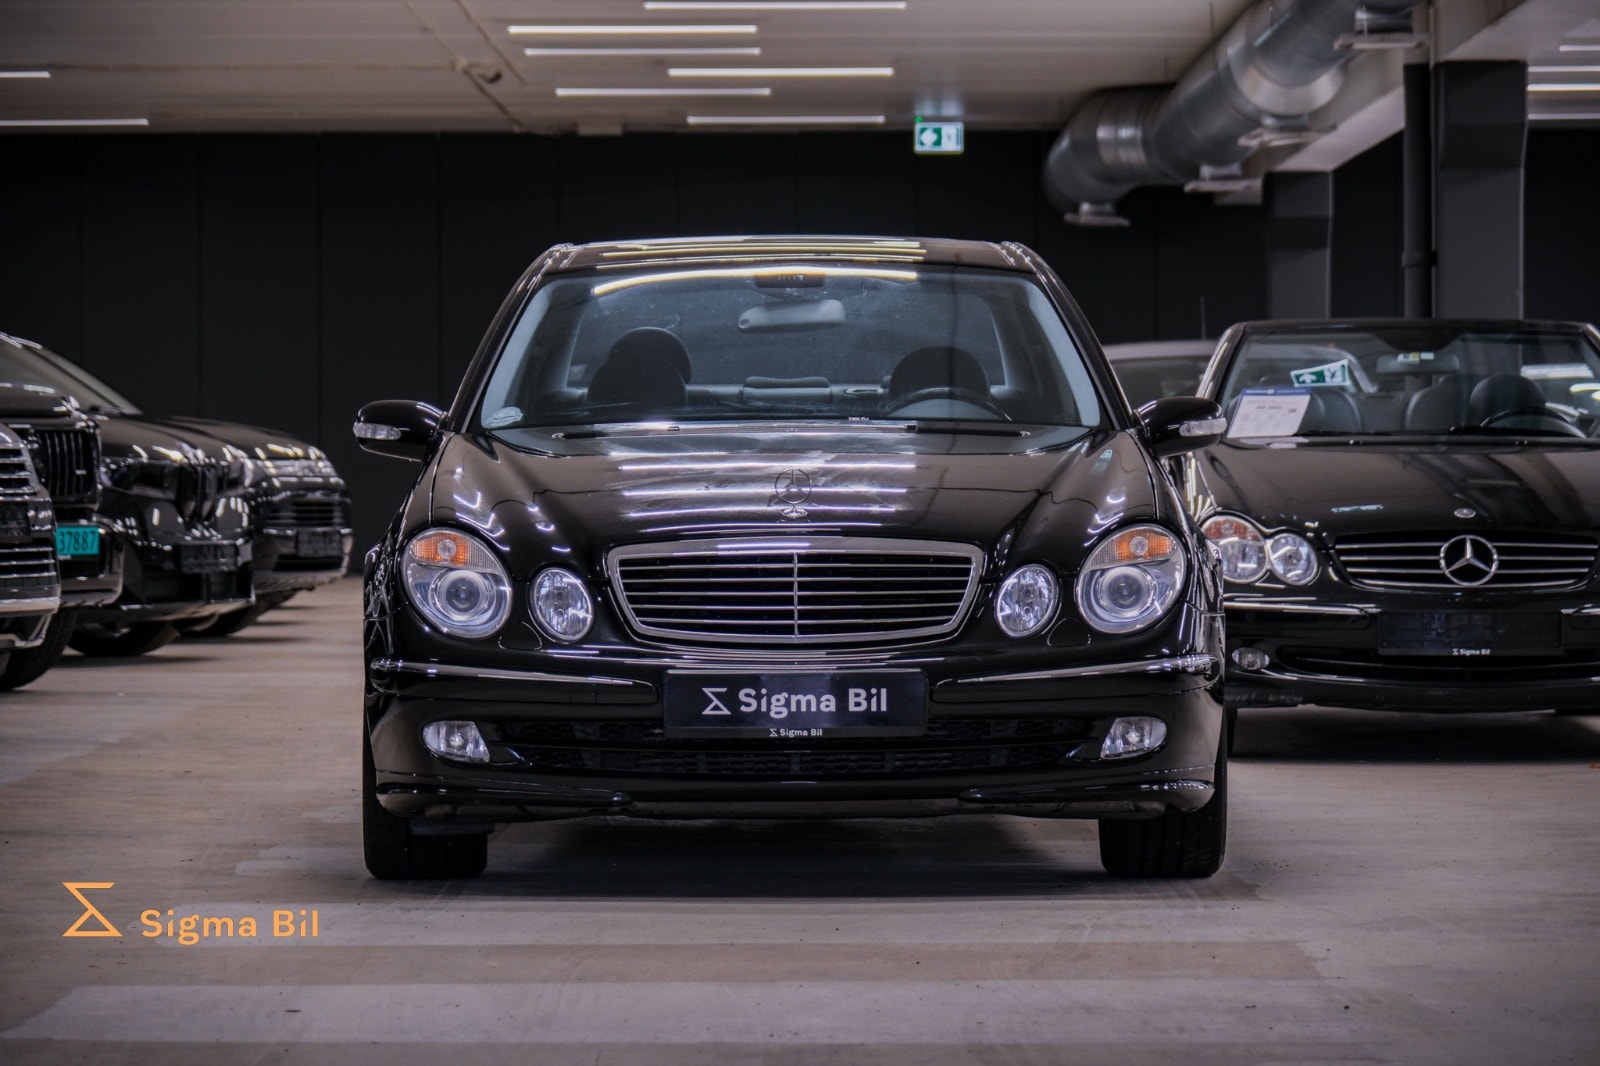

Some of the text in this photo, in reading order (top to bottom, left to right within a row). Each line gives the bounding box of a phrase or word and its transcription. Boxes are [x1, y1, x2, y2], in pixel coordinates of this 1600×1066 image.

[59, 531, 96, 552] 37887
[738, 687, 887, 719] Sigma Bil
[780, 728, 823, 738] Sigma Bil
